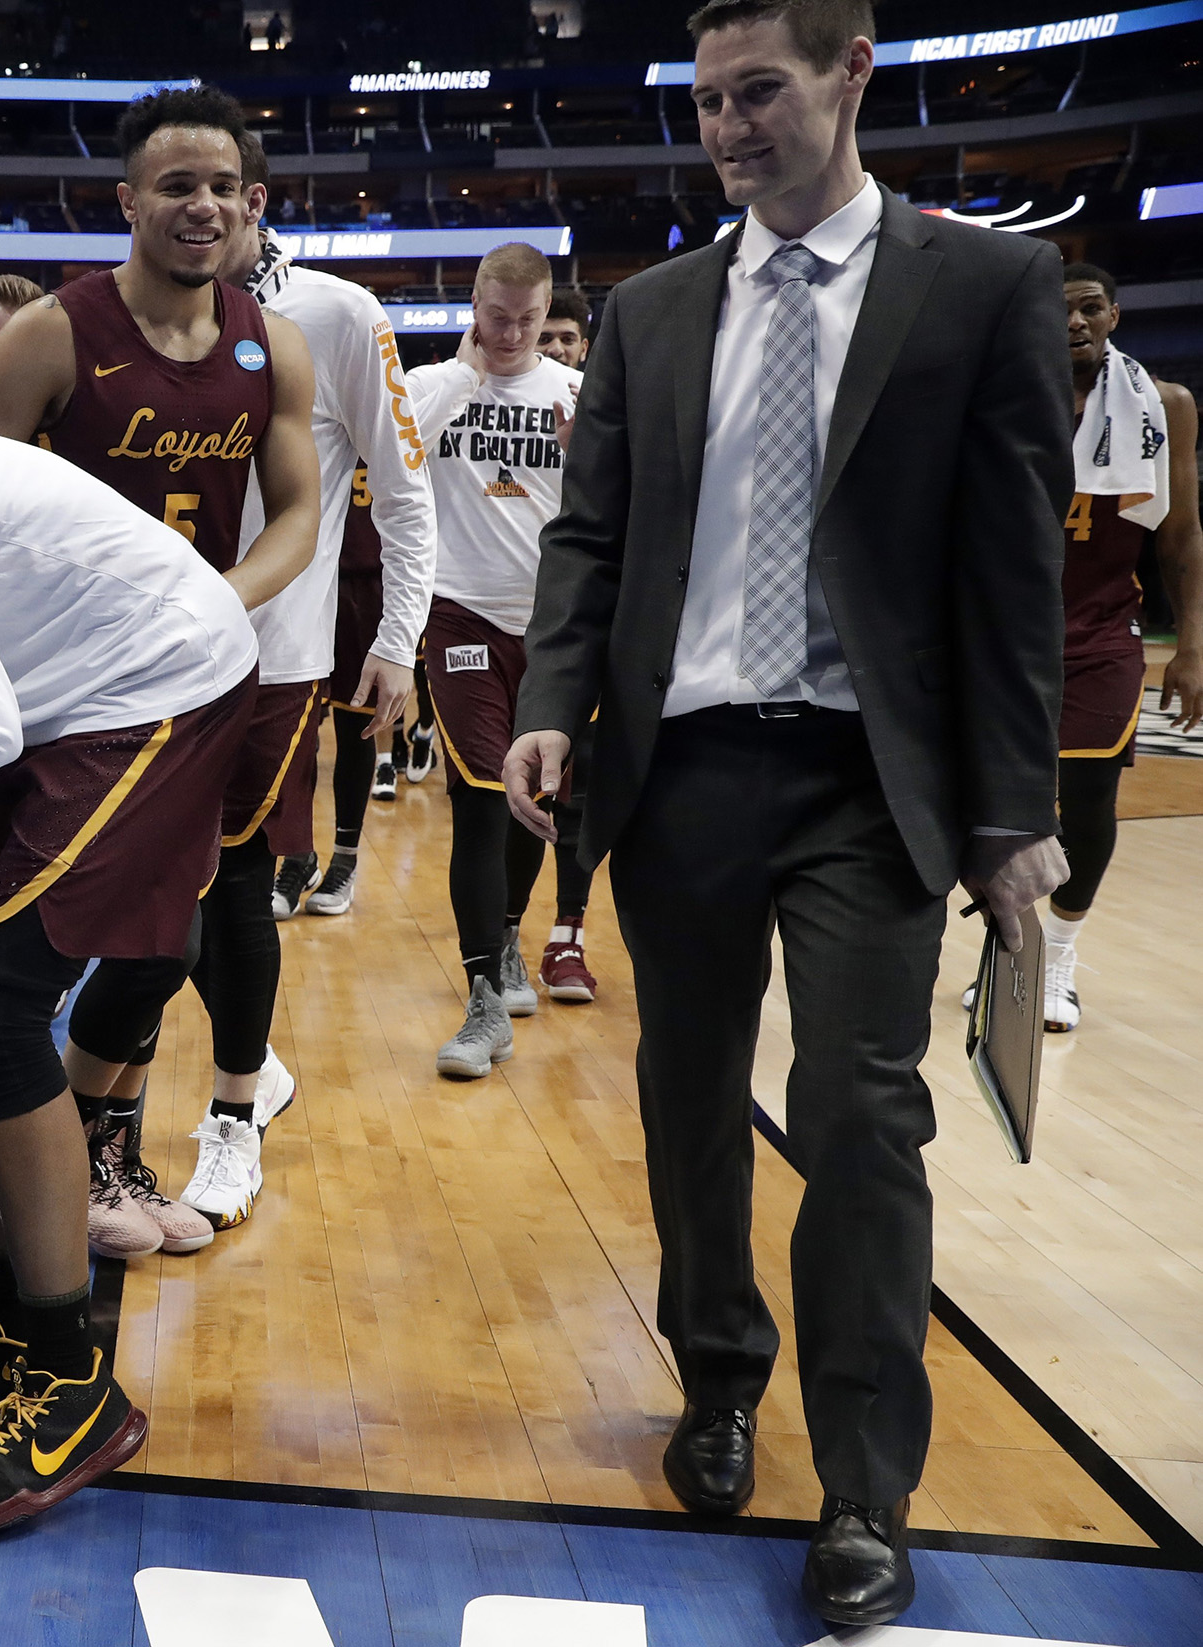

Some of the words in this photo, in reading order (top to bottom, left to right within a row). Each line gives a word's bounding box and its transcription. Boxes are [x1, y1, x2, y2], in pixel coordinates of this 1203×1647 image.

[910, 35, 968, 63] NCAA
[970, 27, 1037, 56] FIRST
[1037, 13, 1119, 48] ROUND
[350, 70, 491, 92] #MARCHMADNESS
[304, 235, 329, 257] VS
[331, 233, 392, 256] MIAMI
[371, 320, 391, 335] LOYOL
[239, 354, 265, 364] NCAA
[107, 407, 253, 472] Loyola
[439, 429, 462, 458] BY
[470, 432, 565, 469] CULTUR
[164, 493, 201, 545] 5
[448, 649, 486, 668] VALLEY
